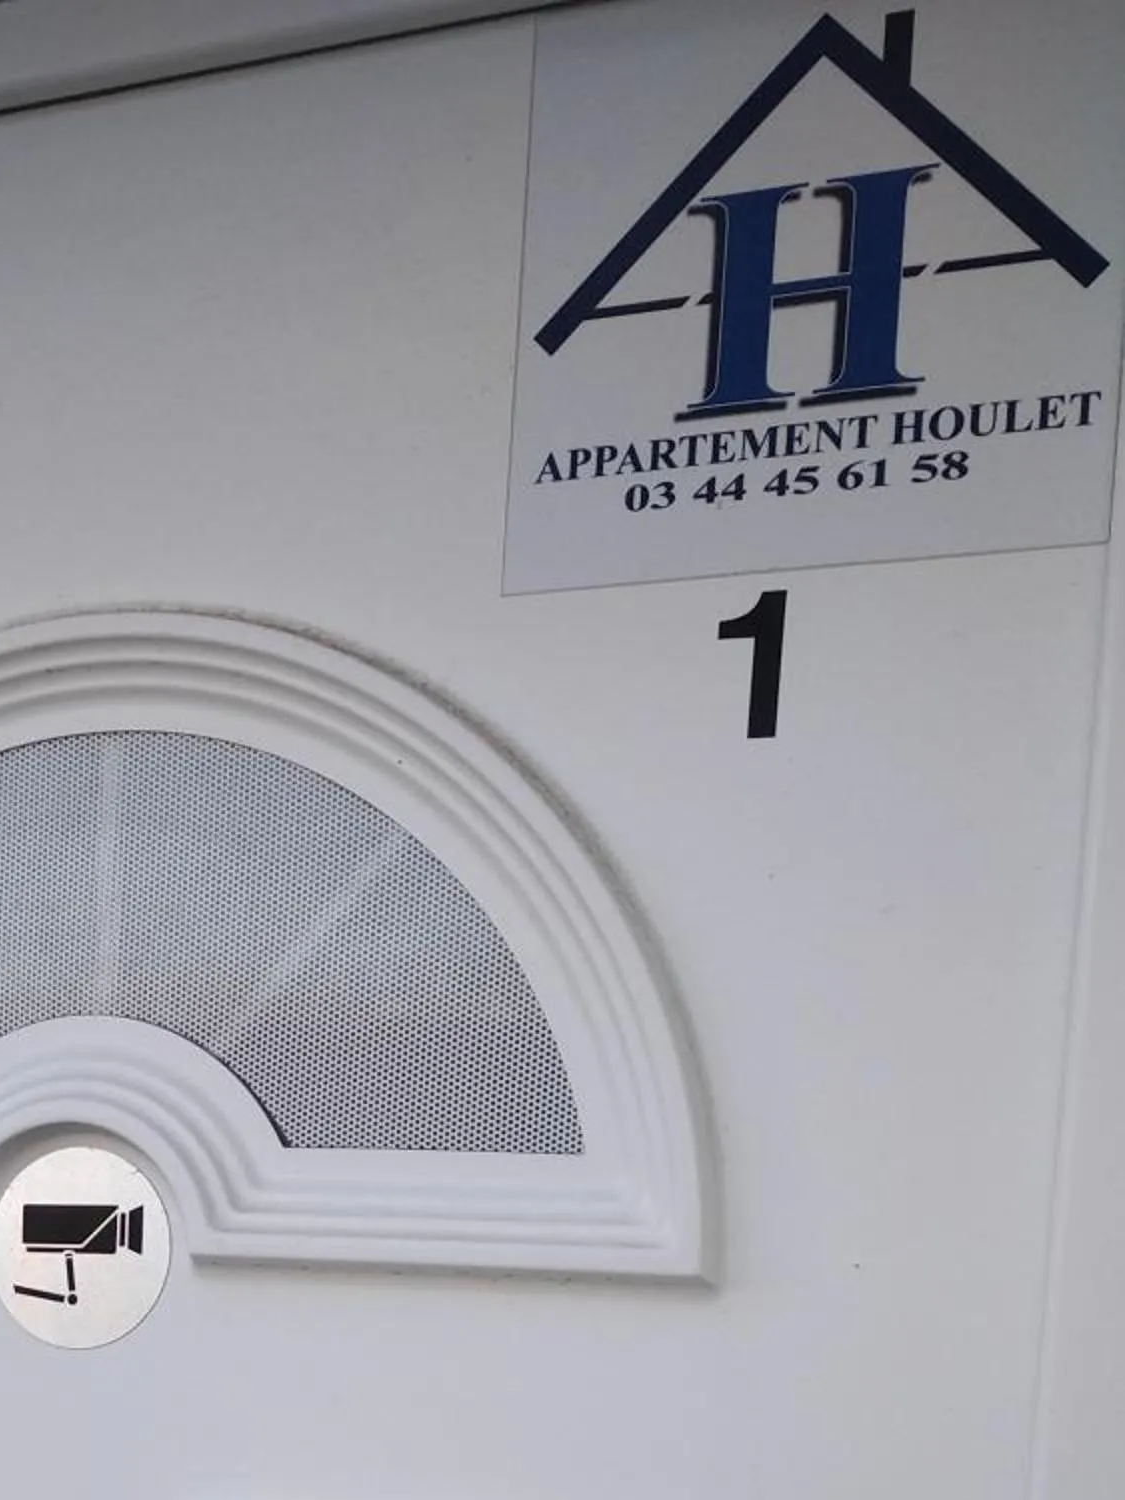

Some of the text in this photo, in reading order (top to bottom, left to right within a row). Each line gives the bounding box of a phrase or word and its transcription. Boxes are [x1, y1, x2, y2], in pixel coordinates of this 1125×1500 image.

[535, 390, 1103, 486] APPARTEMENT HOULET
[624, 450, 970, 513] 03 44 45 61 58
[717, 589, 788, 739] 1
